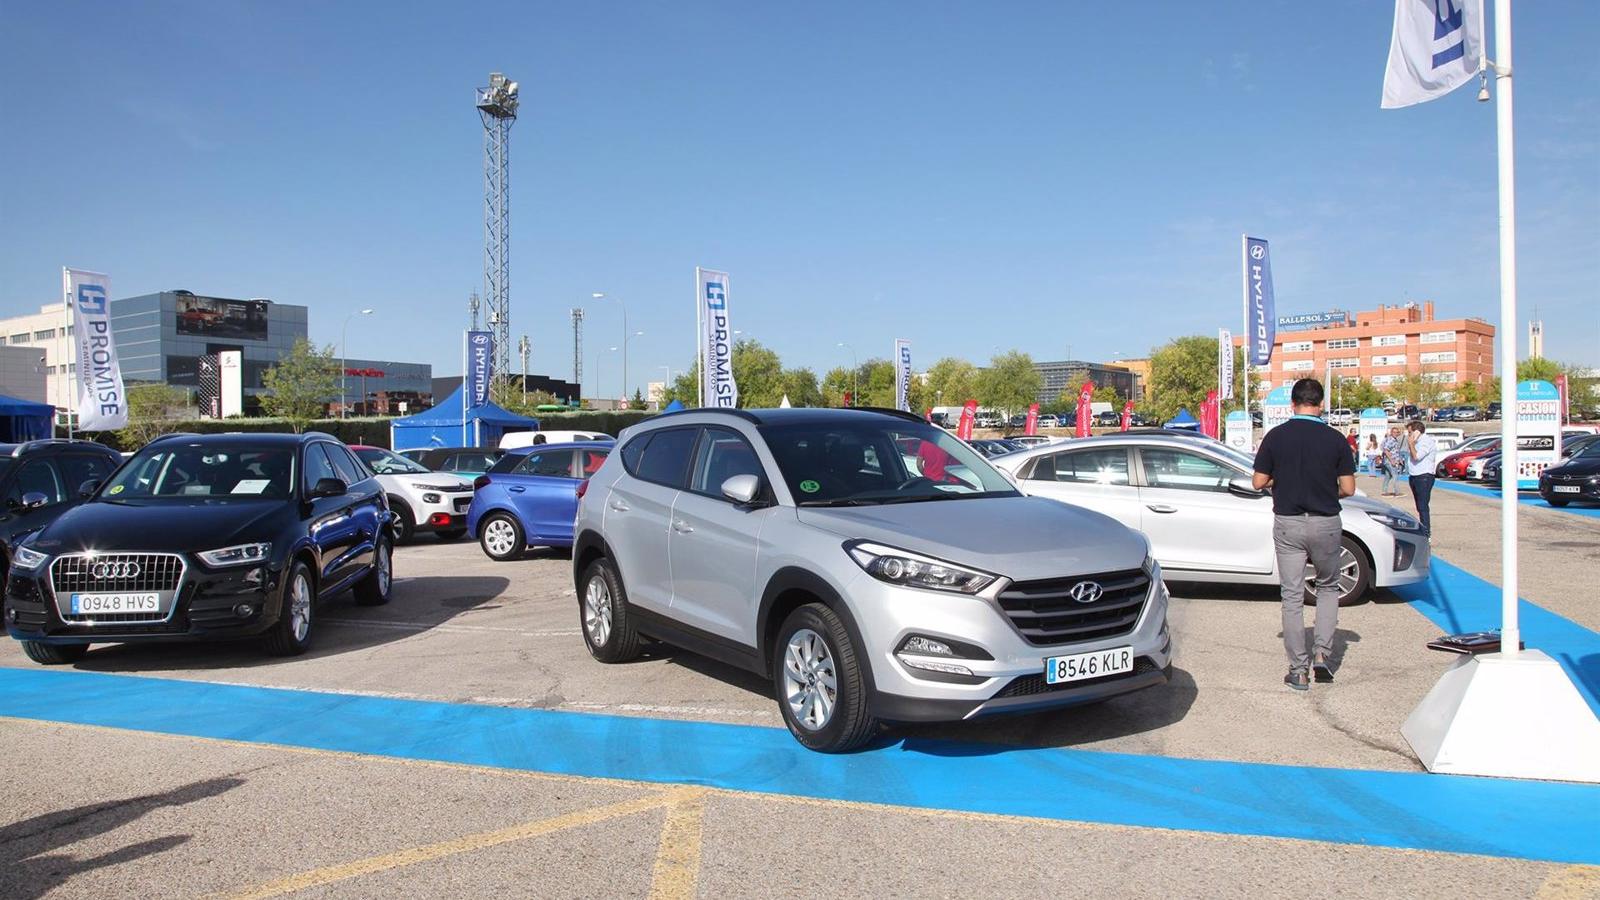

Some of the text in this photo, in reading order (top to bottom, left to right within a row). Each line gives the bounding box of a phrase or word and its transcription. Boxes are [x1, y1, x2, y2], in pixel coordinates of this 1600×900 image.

[1252, 265, 1269, 360] HYUNDAI
[1279, 314, 1323, 325] BALLESOL
[88, 320, 119, 416] PROMISE
[709, 333, 717, 390] SEMINUEVOS
[715, 315, 732, 408] PROMISE
[1517, 402, 1557, 415] CASION
[83, 595, 155, 610] 0948 HVS
[1058, 650, 1129, 679] 8546 KLR
